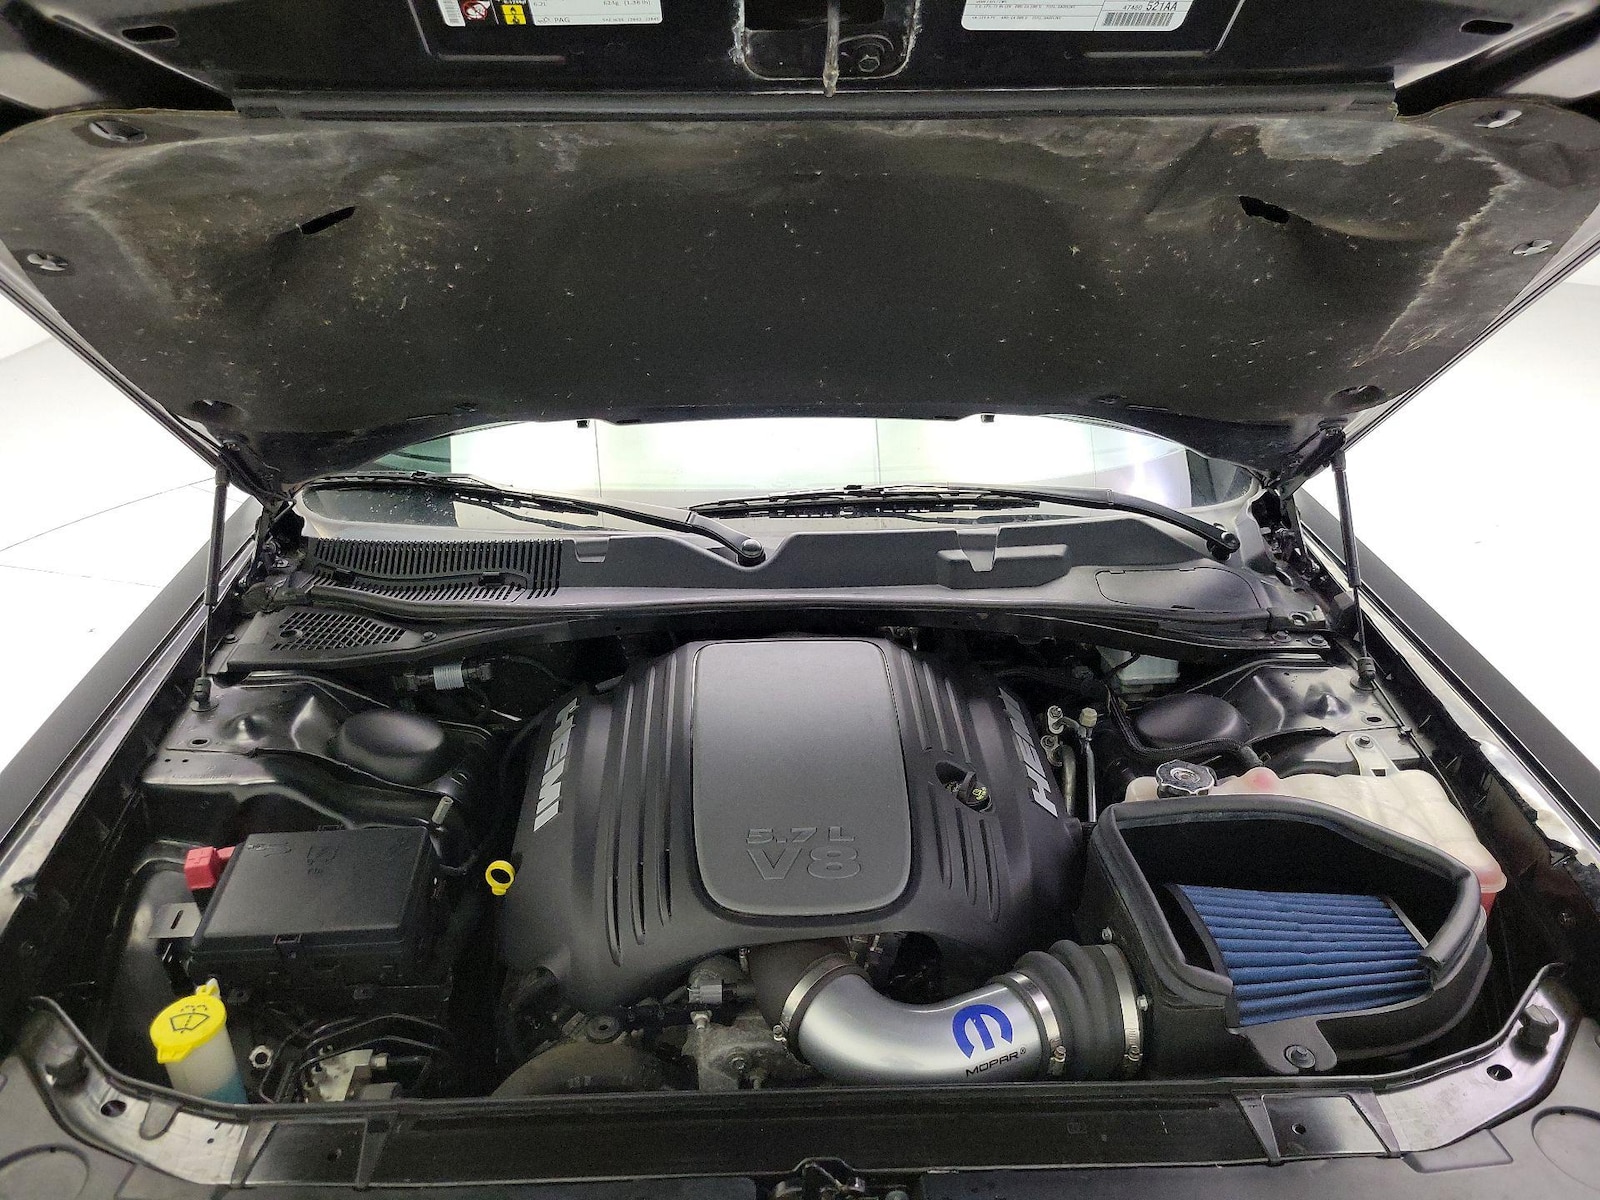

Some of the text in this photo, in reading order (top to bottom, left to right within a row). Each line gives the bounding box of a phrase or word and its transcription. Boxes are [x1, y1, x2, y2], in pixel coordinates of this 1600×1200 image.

[1146, 1, 1178, 11] 521AA
[533, 697, 579, 832] HEMI
[998, 687, 1058, 818] HEMI
[746, 846, 862, 881] V8
